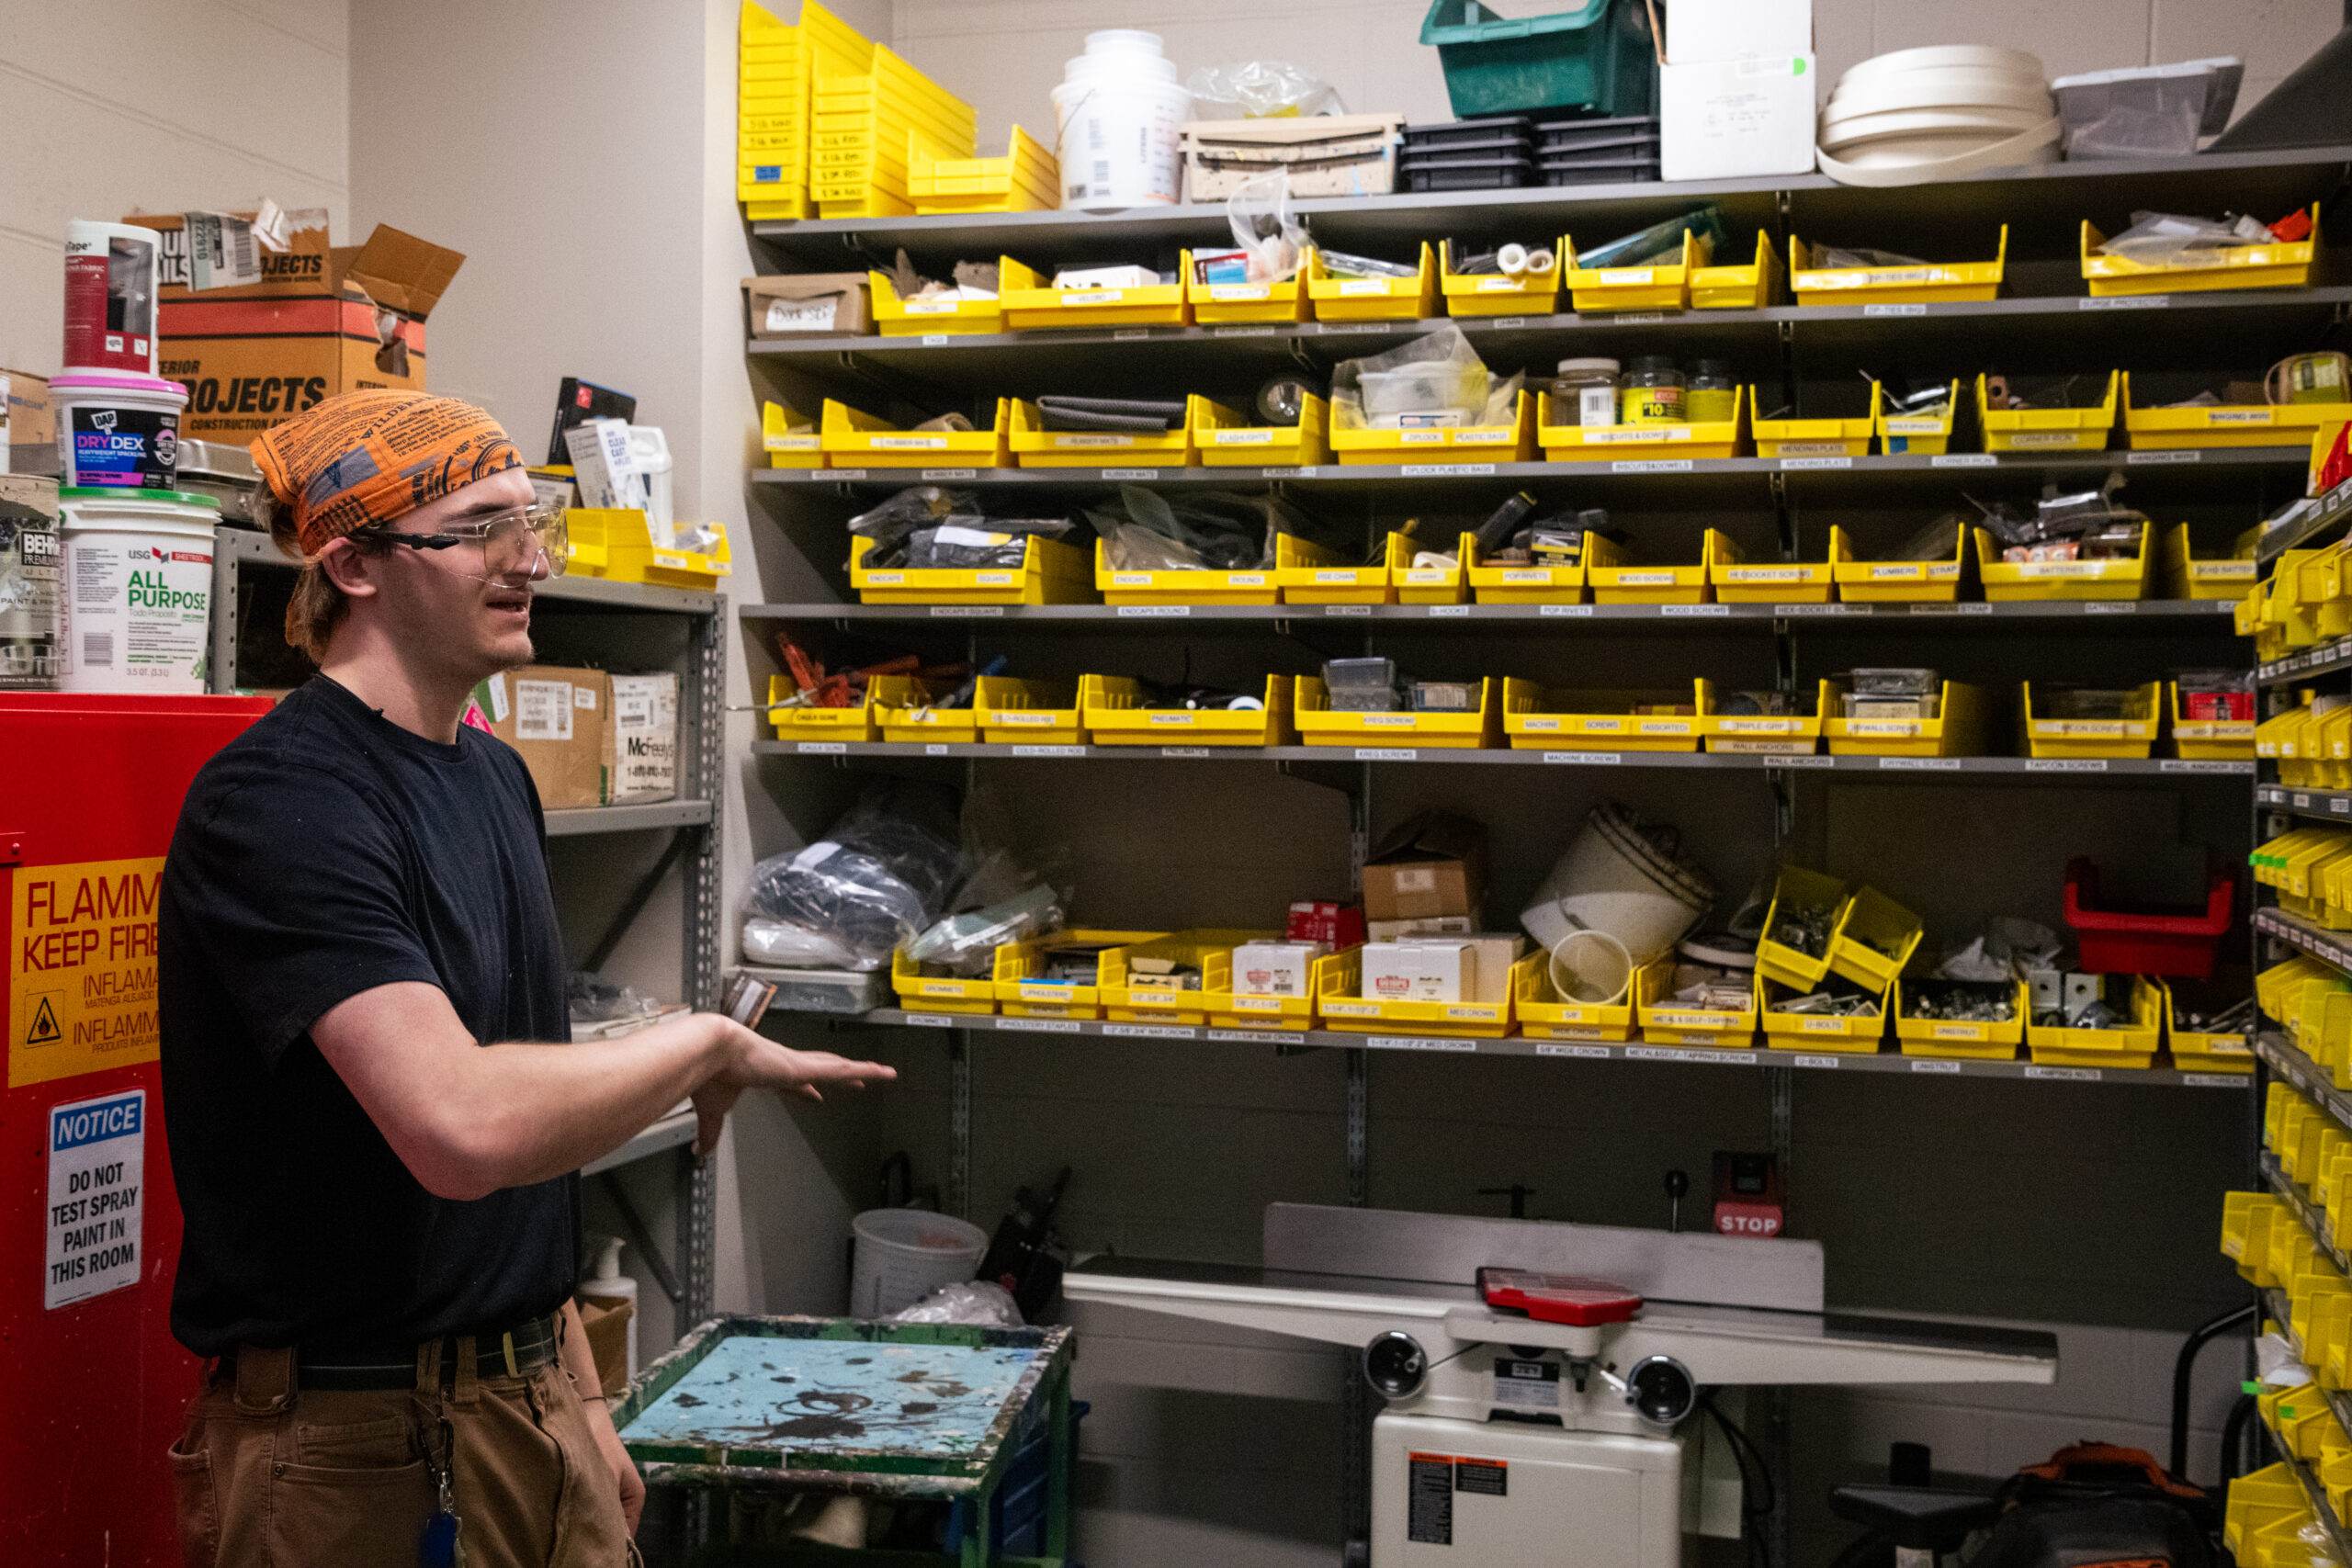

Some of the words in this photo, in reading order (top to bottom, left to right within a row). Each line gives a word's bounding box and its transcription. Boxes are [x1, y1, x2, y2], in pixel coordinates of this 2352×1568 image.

[186, 377, 326, 414] ROJECTS
[95, 412, 115, 427] DAP
[190, 419, 268, 431] CONSTRUCTION
[77, 435, 145, 451] DRYDEX
[1781, 445, 1816, 453] MENDING
[1819, 445, 1844, 453] PLATE
[1786, 459, 1819, 468] MENDING
[1823, 458, 1849, 468] PLATE
[1104, 470, 1134, 479] RUBBER
[1136, 469, 1156, 478] MATS
[1439, 466, 1469, 474] PLASTIC
[1471, 465, 1492, 473] BAGS
[23, 533, 60, 556] BEHR
[129, 549, 151, 560] USG
[1873, 566, 1917, 576] PLUMBERS
[1929, 565, 1957, 575] STRAP
[2039, 565, 2084, 574] BATTERIES
[128, 570, 168, 590] ALL
[871, 574, 902, 582] ENDCAPS
[1115, 575, 1148, 583] ENDCAPS
[1231, 575, 1261, 583] (ROUND)
[1316, 572, 1335, 581] VISE
[1338, 572, 1356, 581] CHAIN
[1505, 572, 1520, 581] POP
[1521, 571, 1548, 581] RIVETS
[1618, 574, 1641, 583] WOOD
[1, 597, 29, 605] PAINT
[128, 589, 206, 611] PURPOSE
[129, 609, 147, 617] Todo
[1120, 607, 1154, 615] ENDCAPS
[1156, 606, 1187, 615] (ROUND)
[1327, 606, 1346, 615] VISE
[1348, 606, 1369, 615] CHAIN
[1544, 606, 1561, 615] POP
[1564, 606, 1590, 615] RIVETS
[1666, 606, 1690, 615] WOOD
[1692, 606, 1726, 615] SCREWS
[1960, 604, 1989, 613] STRAP
[127, 668, 139, 676] 3.5
[1151, 715, 1193, 723] PNEUMATIC
[1525, 720, 1558, 729] MACHINE
[1586, 720, 1619, 729] SCREWS
[1733, 741, 1753, 750] WALL
[1755, 741, 1793, 750] ANCHORS
[1360, 750, 1379, 759] KREG
[1382, 750, 1414, 759] SCREWS
[1547, 753, 1582, 762] MACHINE
[1585, 754, 1617, 763] SCREWS
[1767, 757, 1789, 765] WALL
[1791, 757, 1829, 767] ANCHORS
[2030, 761, 2064, 770] TAPCON
[2067, 761, 2103, 770] SCREWS
[28, 871, 163, 928] FLAMM
[23, 929, 99, 973] KEEP
[84, 966, 159, 998] INFLAM
[924, 984, 963, 993] GROMMETS
[1025, 988, 1068, 998] UPHOLSTERY
[85, 997, 121, 1010] MATENGA
[122, 990, 154, 1004] ALEJADO
[1450, 1008, 1464, 1016] MED
[1466, 1009, 1495, 1018] CROWN
[910, 1017, 949, 1026] GROMMETS
[1653, 1015, 1674, 1024] METAL
[74, 1010, 161, 1046] INFLAMM
[1001, 1021, 1044, 1030] UPHOLSTERY
[1046, 1022, 1078, 1031] STAPLES
[1805, 1021, 1841, 1030] U-BOLTS
[1148, 1027, 1163, 1035] NAR
[1165, 1028, 1192, 1036] CROWN
[92, 1037, 129, 1054] PRODUITS
[1443, 1042, 1472, 1050] CROWN
[1555, 1046, 1574, 1055] WIDE
[1577, 1047, 1606, 1056] CROWN
[1719, 1053, 1753, 1063] SCREWS
[1798, 1057, 1835, 1066] U-BOLTS
[1915, 1061, 1956, 1070] UNISTRUT
[57, 1102, 138, 1145] NOTICE
[69, 1170, 90, 1194] DO
[95, 1162, 124, 1189] NOT
[51, 1199, 87, 1227] TEST
[90, 1186, 138, 1217] SPRAY
[1721, 1214, 1778, 1234] STOP
[63, 1222, 107, 1253] PAINT
[109, 1217, 125, 1240] IN
[51, 1256, 85, 1285] THIS
[90, 1243, 134, 1274] ROOM
